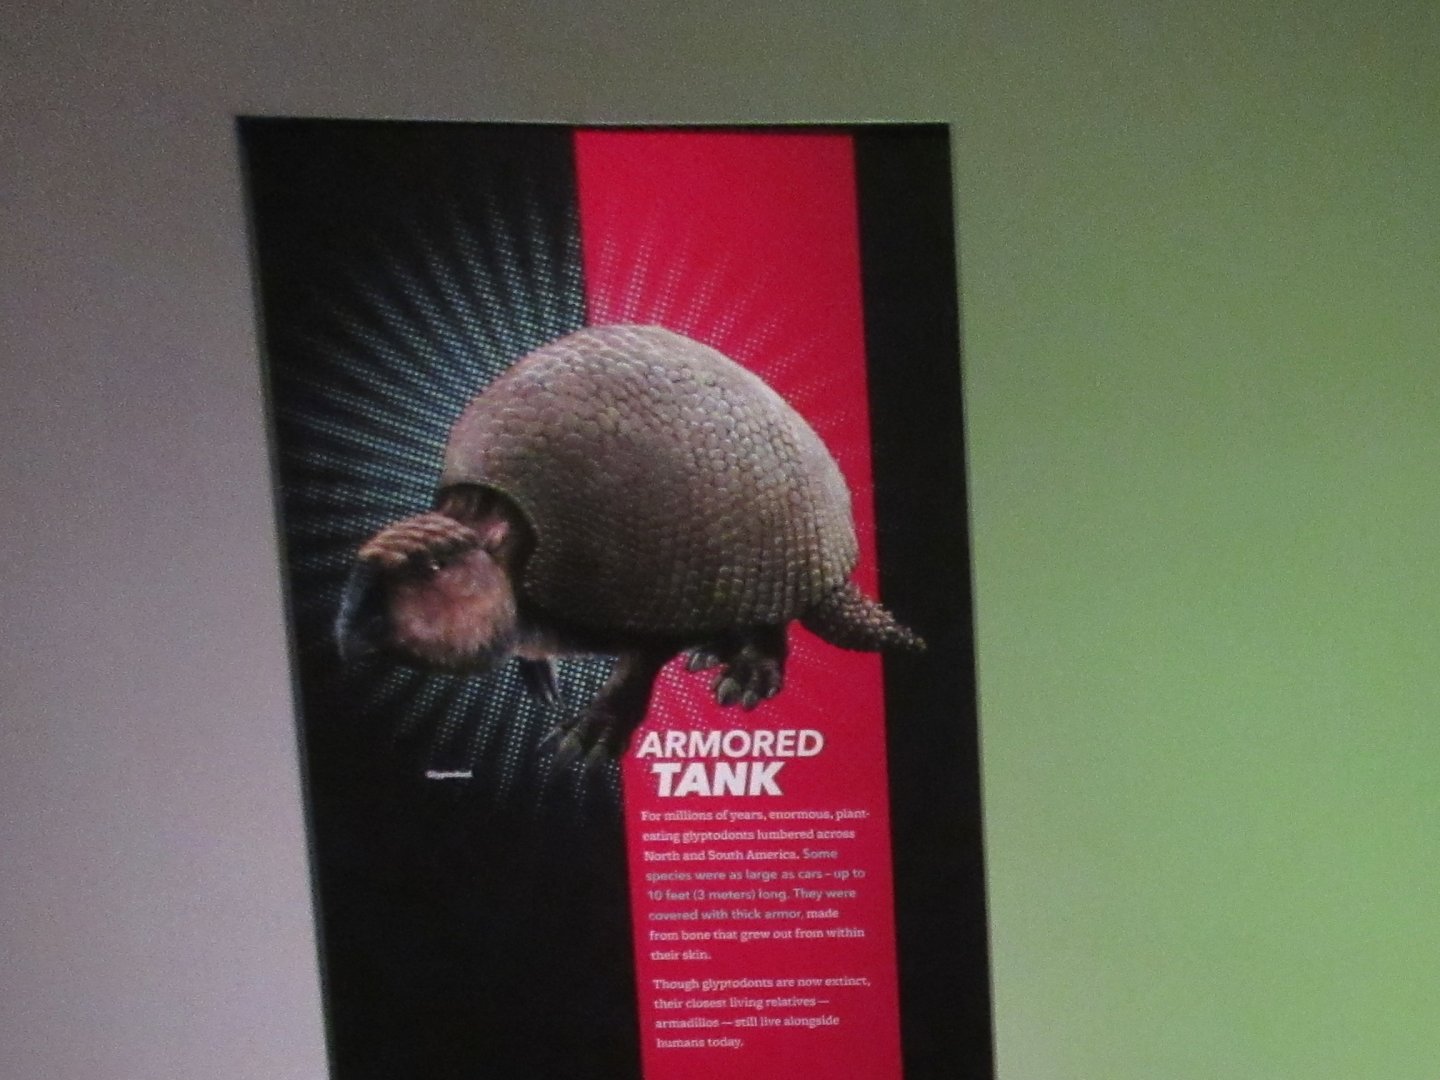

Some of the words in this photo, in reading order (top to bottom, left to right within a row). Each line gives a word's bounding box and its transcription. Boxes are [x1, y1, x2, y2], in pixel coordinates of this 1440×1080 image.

[636, 729, 824, 758] ARMORED
[651, 761, 786, 797] TANK
[641, 810, 661, 821] For
[664, 809, 713, 821] millions
[716, 809, 728, 820] of
[730, 811, 770, 823] years,
[836, 808, 870, 821] plant-
[642, 830, 681, 844] eating
[682, 829, 755, 844] glyptodonts
[758, 828, 814, 840] lumbered
[817, 830, 856, 839] across
[644, 850, 680, 861] North
[683, 850, 706, 861] and
[708, 849, 744, 861] South
[746, 848, 800, 860] America.
[804, 847, 838, 859] Some
[646, 870, 692, 884] species
[695, 871, 726, 880] were
[729, 871, 742, 880] as
[746, 869, 777, 883] large
[782, 871, 794, 880] as
[798, 870, 822, 879] cars
[834, 870, 850, 881] up
[853, 868, 866, 878] to
[648, 889, 664, 901] 10
[666, 889, 690, 900] feet
[709, 889, 756, 900] meters)
[758, 888, 790, 902] long.
[795, 887, 822, 901] They
[827, 889, 857, 898] were
[649, 908, 699, 921] covered
[702, 908, 728, 920] with
[732, 908, 761, 920] thick
[765, 910, 804, 920] armor,
[807, 908, 839, 919] made
[649, 930, 679, 941] from
[681, 930, 711, 941] bone
[714, 929, 738, 940] that
[740, 930, 770, 942] grew
[773, 930, 792, 939] out
[795, 927, 824, 939] from
[827, 927, 865, 938] within
[650, 949, 678, 960] their
[683, 949, 712, 960] skin.
[653, 978, 700, 992] Though
[702, 977, 774, 992] glyptodonts
[776, 979, 795, 987] are
[798, 978, 822, 987] now
[825, 975, 871, 987] extinct,
[654, 998, 682, 1009] their
[686, 998, 727, 1009] closest
[730, 996, 764, 1011] living
[656, 1017, 720, 1029] armadillos
[734, 1016, 758, 1027] still
[760, 1016, 782, 1027] live
[784, 1014, 840, 1029] alongside
[656, 1038, 705, 1048] humans
[708, 1036, 744, 1049] today.
